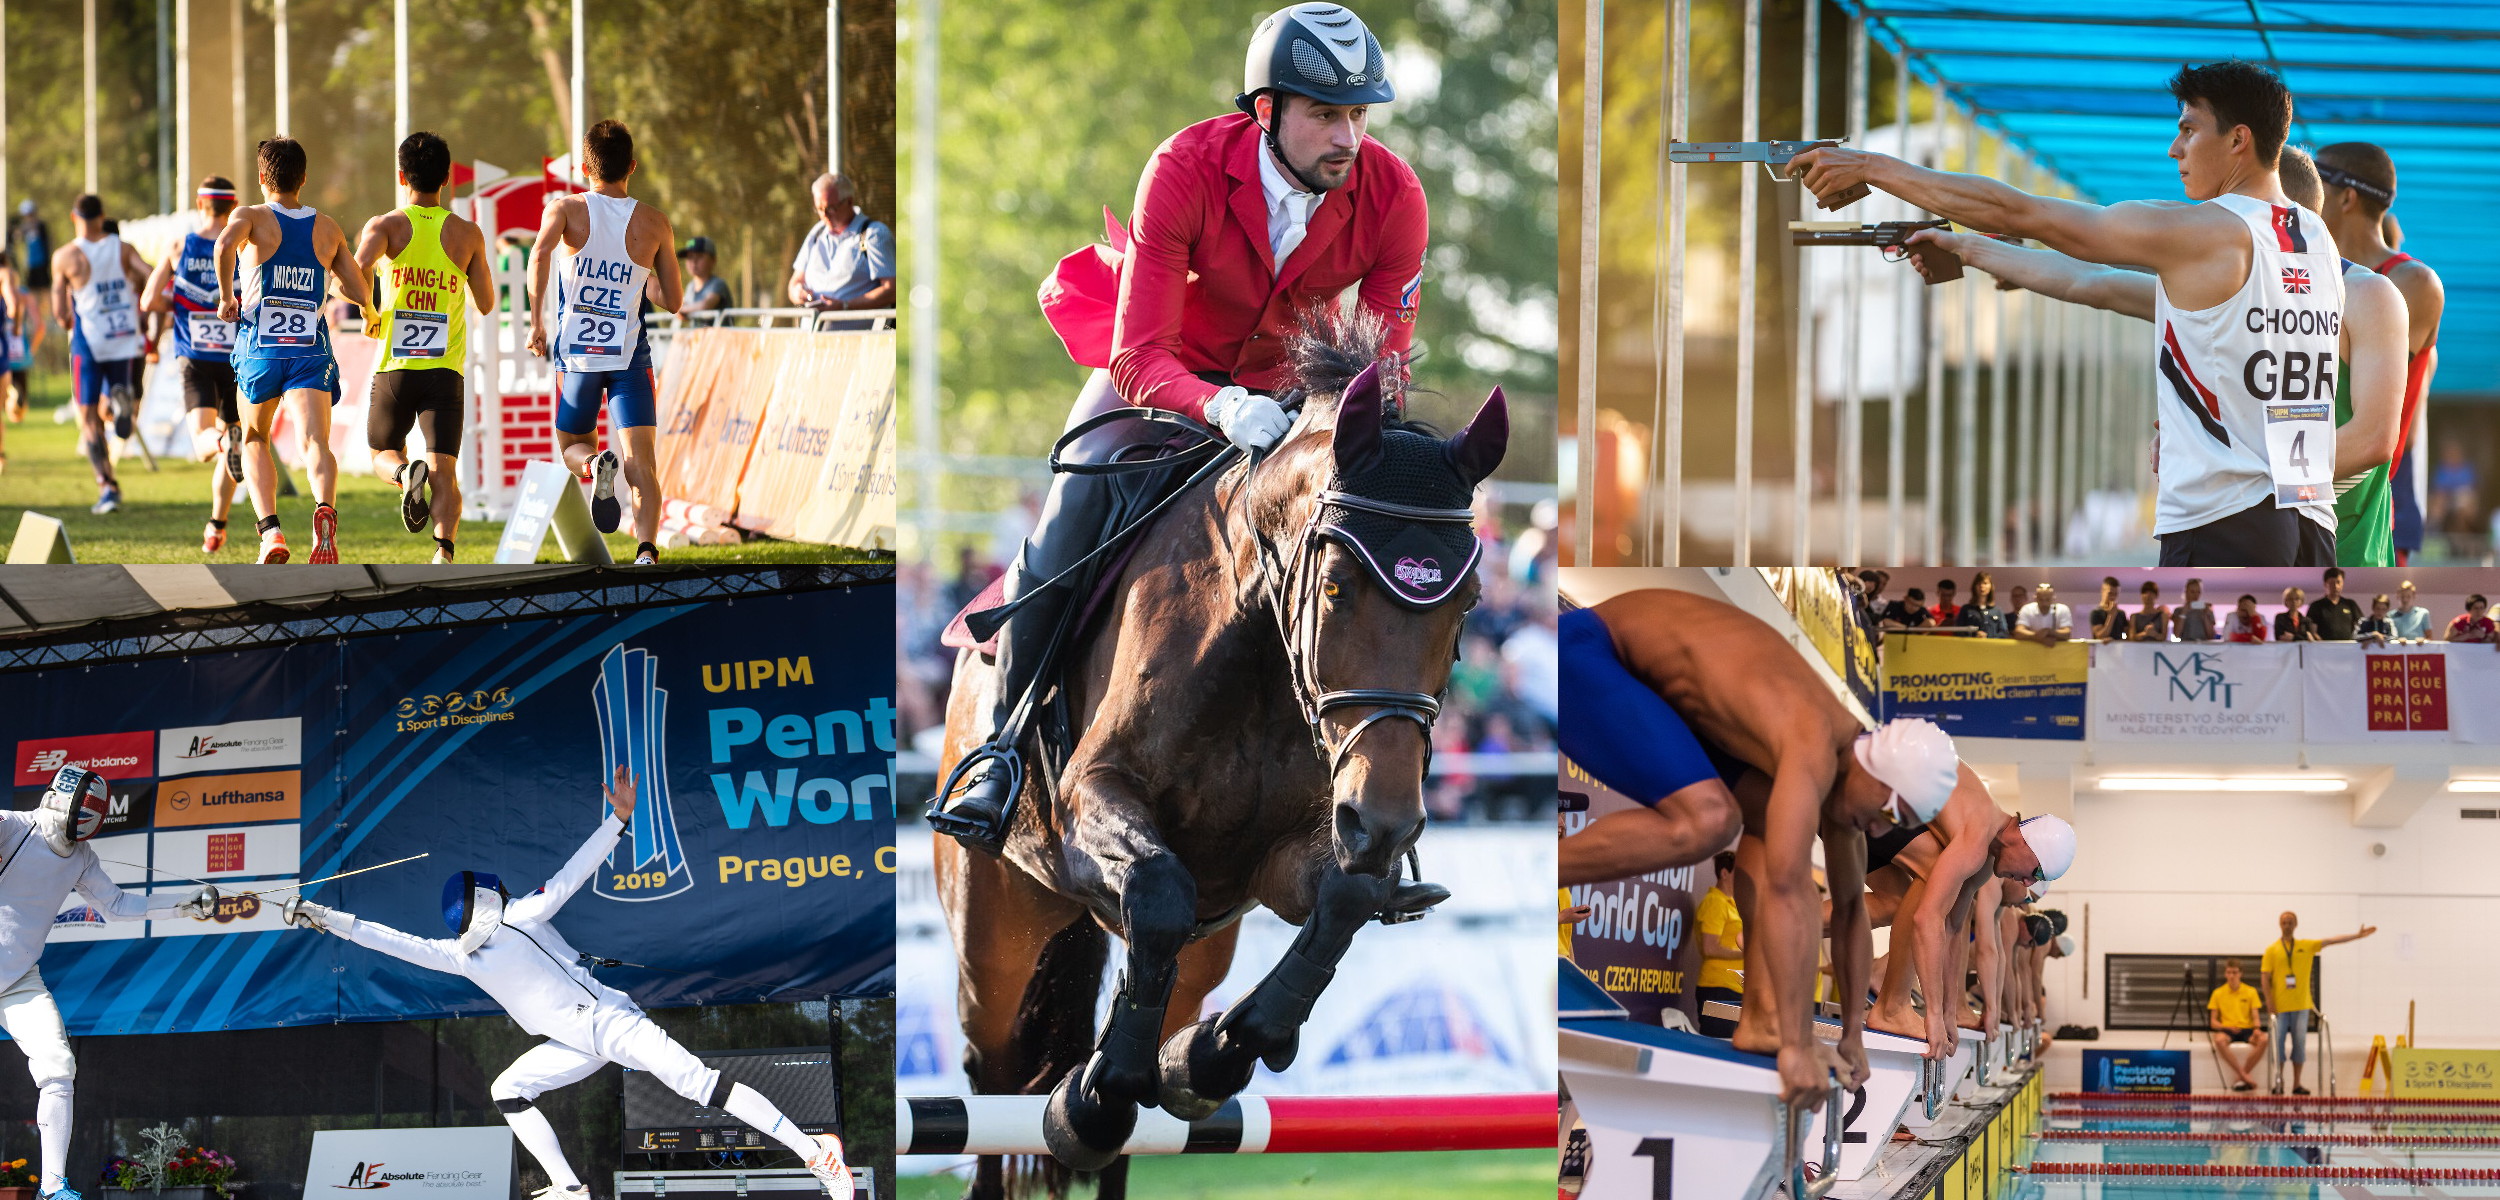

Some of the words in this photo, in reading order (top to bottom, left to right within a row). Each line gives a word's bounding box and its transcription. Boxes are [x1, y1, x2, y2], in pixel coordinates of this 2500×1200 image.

[273, 264, 315, 292] MICOZZI
[575, 256, 633, 285] VLACH
[406, 289, 437, 312] CHN
[579, 285, 622, 309] CZE
[268, 311, 306, 334] 28
[577, 317, 616, 343] 29
[2246, 307, 2339, 337] CHOONG
[200, 324, 227, 342] 23
[401, 323, 439, 348] 27
[2289, 430, 2310, 478] 4
[702, 656, 814, 693] UIPM
[2372, 660, 2402, 672] PRA
[2409, 660, 2431, 672] HA
[1890, 672, 1994, 688] PROMOTING
[1996, 674, 2027, 685] clean
[2372, 677, 2403, 689] PRA
[2410, 677, 2442, 689] GUE
[1897, 686, 2007, 704] PROTECTING
[2007, 689, 2038, 699] clean
[2039, 687, 2082, 698] athletes
[2373, 694, 2404, 706] PRA
[2410, 694, 2432, 706] GA
[396, 721, 405, 732] 1
[406, 718, 439, 732] Sport
[440, 716, 448, 727] 5
[451, 711, 515, 726] Disciplines
[2106, 713, 2212, 724] MINISTERSTVO
[2374, 711, 2404, 723] PRA
[2411, 711, 2422, 723] G
[708, 697, 896, 763] Pent
[2180, 726, 2188, 734] A
[210, 740, 242, 749] Absolute
[243, 738, 268, 747] Fencing
[269, 737, 285, 745] Gear
[91, 756, 138, 768] balance
[202, 790, 285, 806] Lufthansa
[103, 815, 128, 824] ATCHES
[719, 853, 864, 888] Prague,
[613, 871, 667, 891] 2019
[1642, 891, 1683, 960] Cup
[1604, 965, 1639, 992] CZECH
[1640, 967, 1684, 994] REPUBLIC
[2114, 1065, 2175, 1076] Pentathlon
[2114, 1075, 2147, 1085] World
[2149, 1075, 2171, 1087] Cup
[2413, 1080, 2436, 1090] Sport
[2438, 1079, 2444, 1088] 5
[2446, 1080, 2493, 1090] Disciplines
[1823, 1084, 1867, 1143] 2
[380, 1172, 425, 1182] Absolute
[426, 1171, 460, 1181] Fencing
[461, 1170, 483, 1180] Gear
[1632, 1137, 1674, 1200] 1
[435, 1180, 465, 1188] absolute
